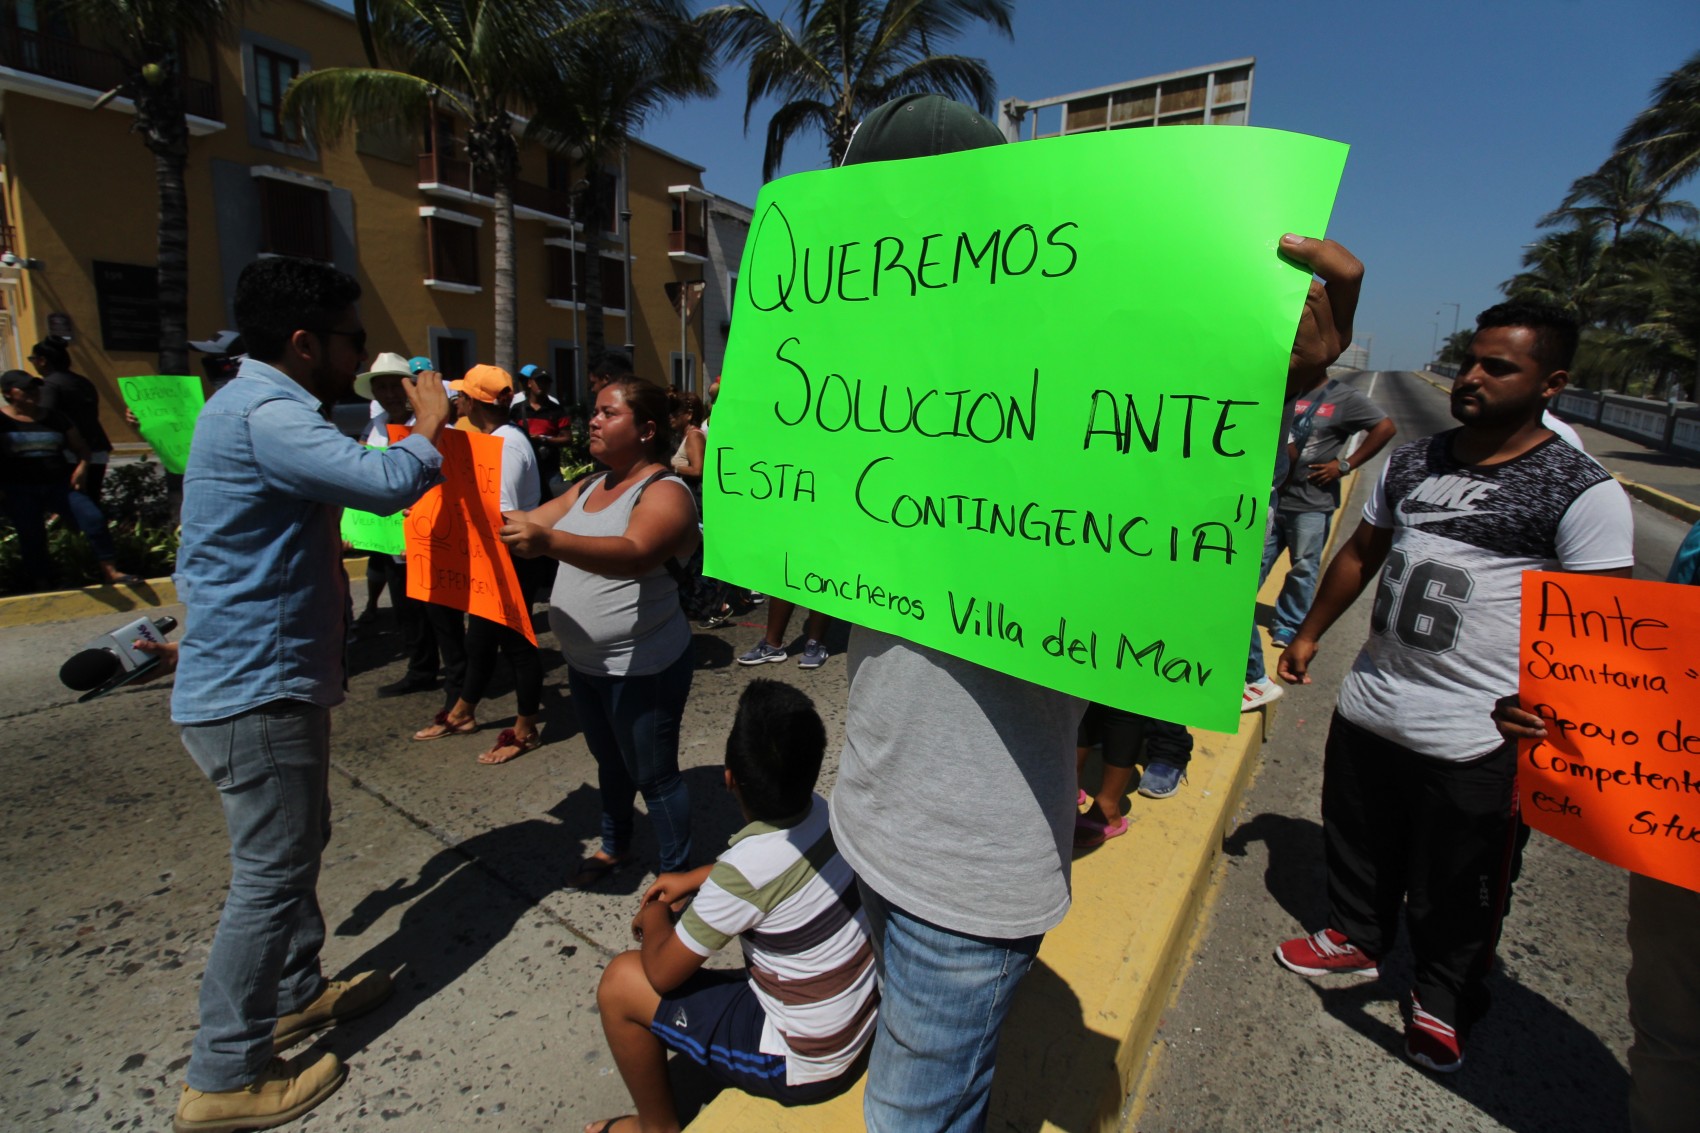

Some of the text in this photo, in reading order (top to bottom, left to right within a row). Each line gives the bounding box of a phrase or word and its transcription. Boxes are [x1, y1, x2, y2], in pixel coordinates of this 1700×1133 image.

[749, 201, 1079, 313] QUEREMOS
[775, 337, 1261, 458] SOLUCION ANTE
[718, 446, 817, 502] ESTA
[1408, 475, 1501, 511] NIKE
[784, 552, 1213, 688] Loncheros Villa del Mar
[1537, 581, 1669, 651] Ante
[1527, 640, 1669, 694] Sanitaria
[1532, 791, 1583, 819] esta
